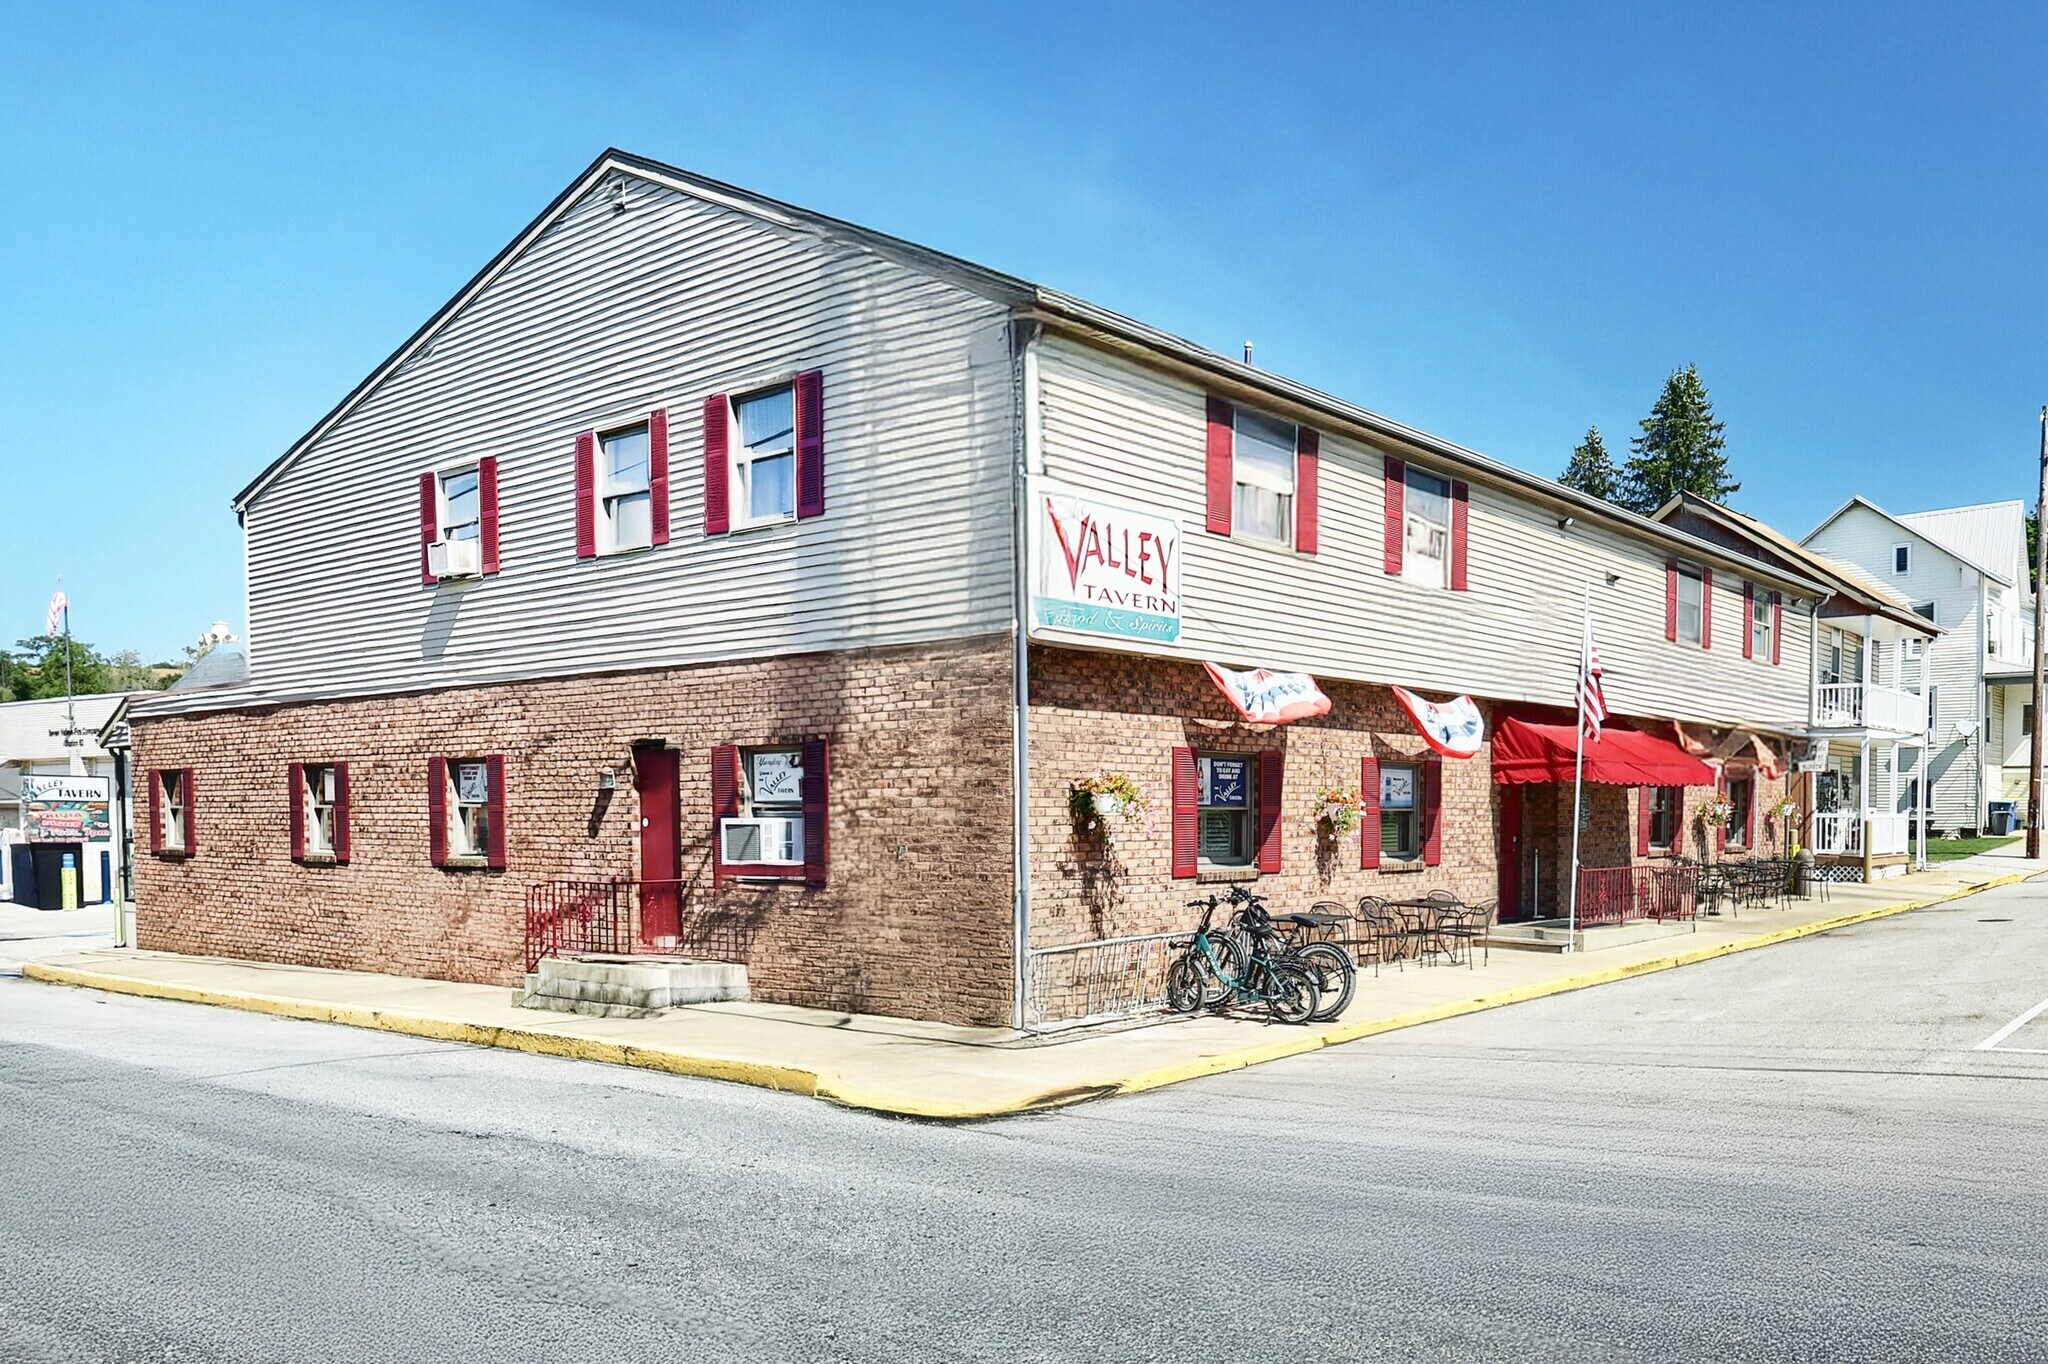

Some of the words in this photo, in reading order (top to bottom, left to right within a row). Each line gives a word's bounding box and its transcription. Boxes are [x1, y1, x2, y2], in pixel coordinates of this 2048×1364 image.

[1046, 497, 1174, 597] VALLEY
[1083, 584, 1176, 613] TAVERN
[1104, 610, 1125, 631] &
[1129, 616, 1174, 634] Spirits
[58, 789, 102, 798] TAVERN
[1215, 781, 1237, 802] VALLEY
